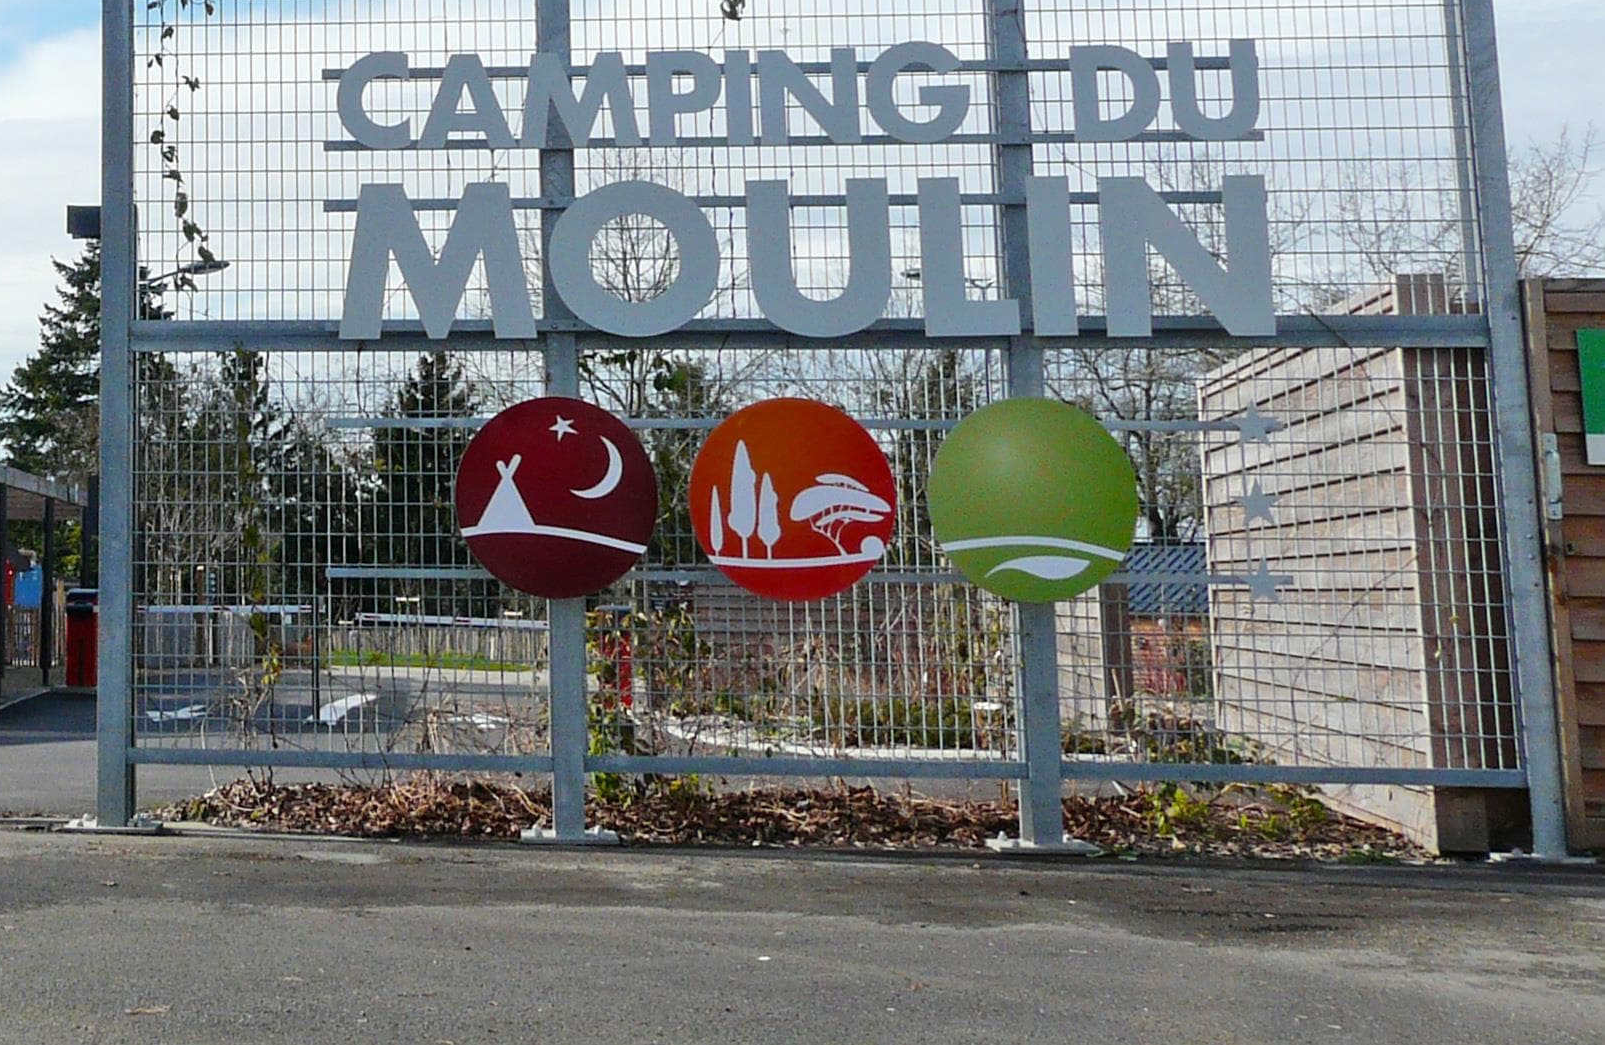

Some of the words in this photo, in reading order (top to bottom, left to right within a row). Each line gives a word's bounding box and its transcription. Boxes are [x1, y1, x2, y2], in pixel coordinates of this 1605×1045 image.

[337, 41, 971, 149] CAMPING
[1070, 38, 1260, 142] DU
[339, 175, 1276, 340] MOULIN
